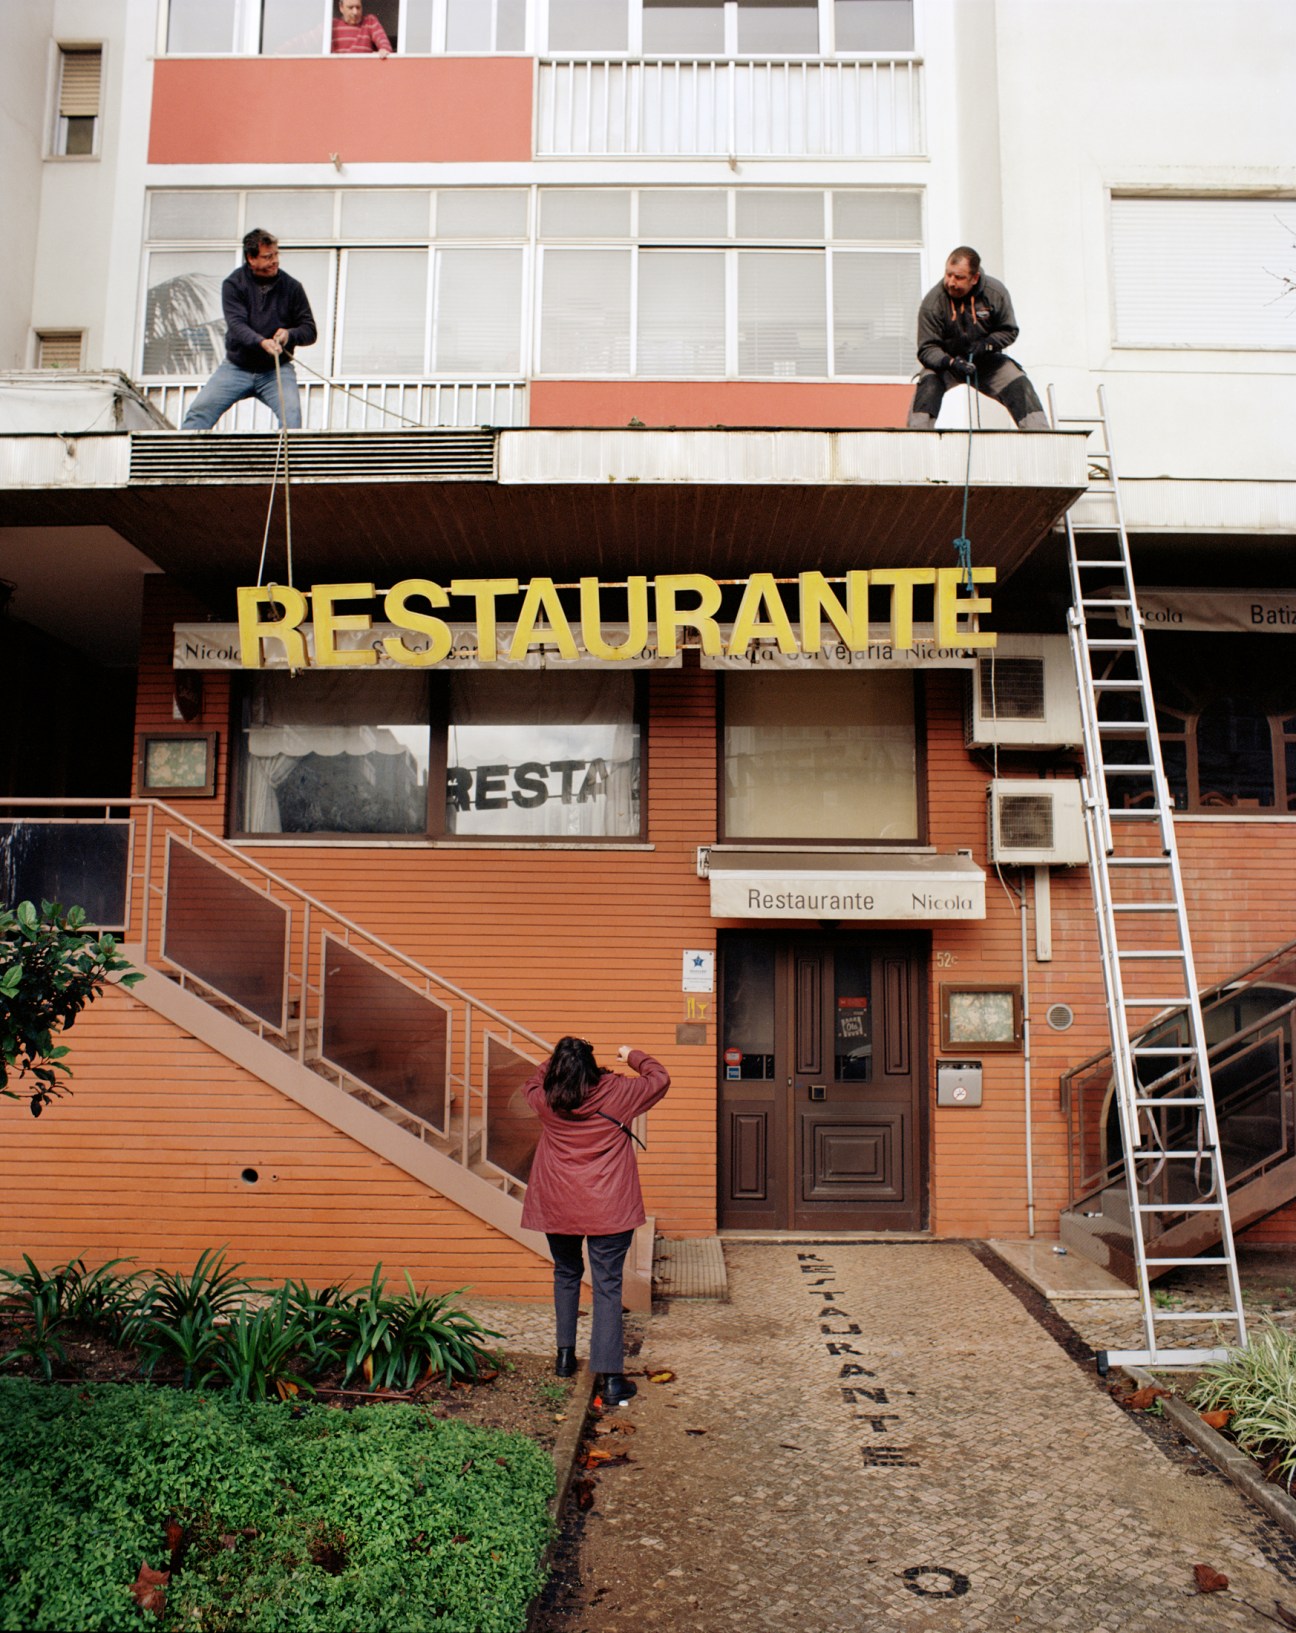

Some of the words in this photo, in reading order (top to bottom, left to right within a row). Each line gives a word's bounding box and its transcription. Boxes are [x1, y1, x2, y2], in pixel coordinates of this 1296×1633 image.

[237, 567, 997, 668] RESTAURANTE
[748, 888, 875, 910] Restaurante
[912, 893, 973, 910] Nicola
[797, 1253, 921, 1468] RESTAURANTE
